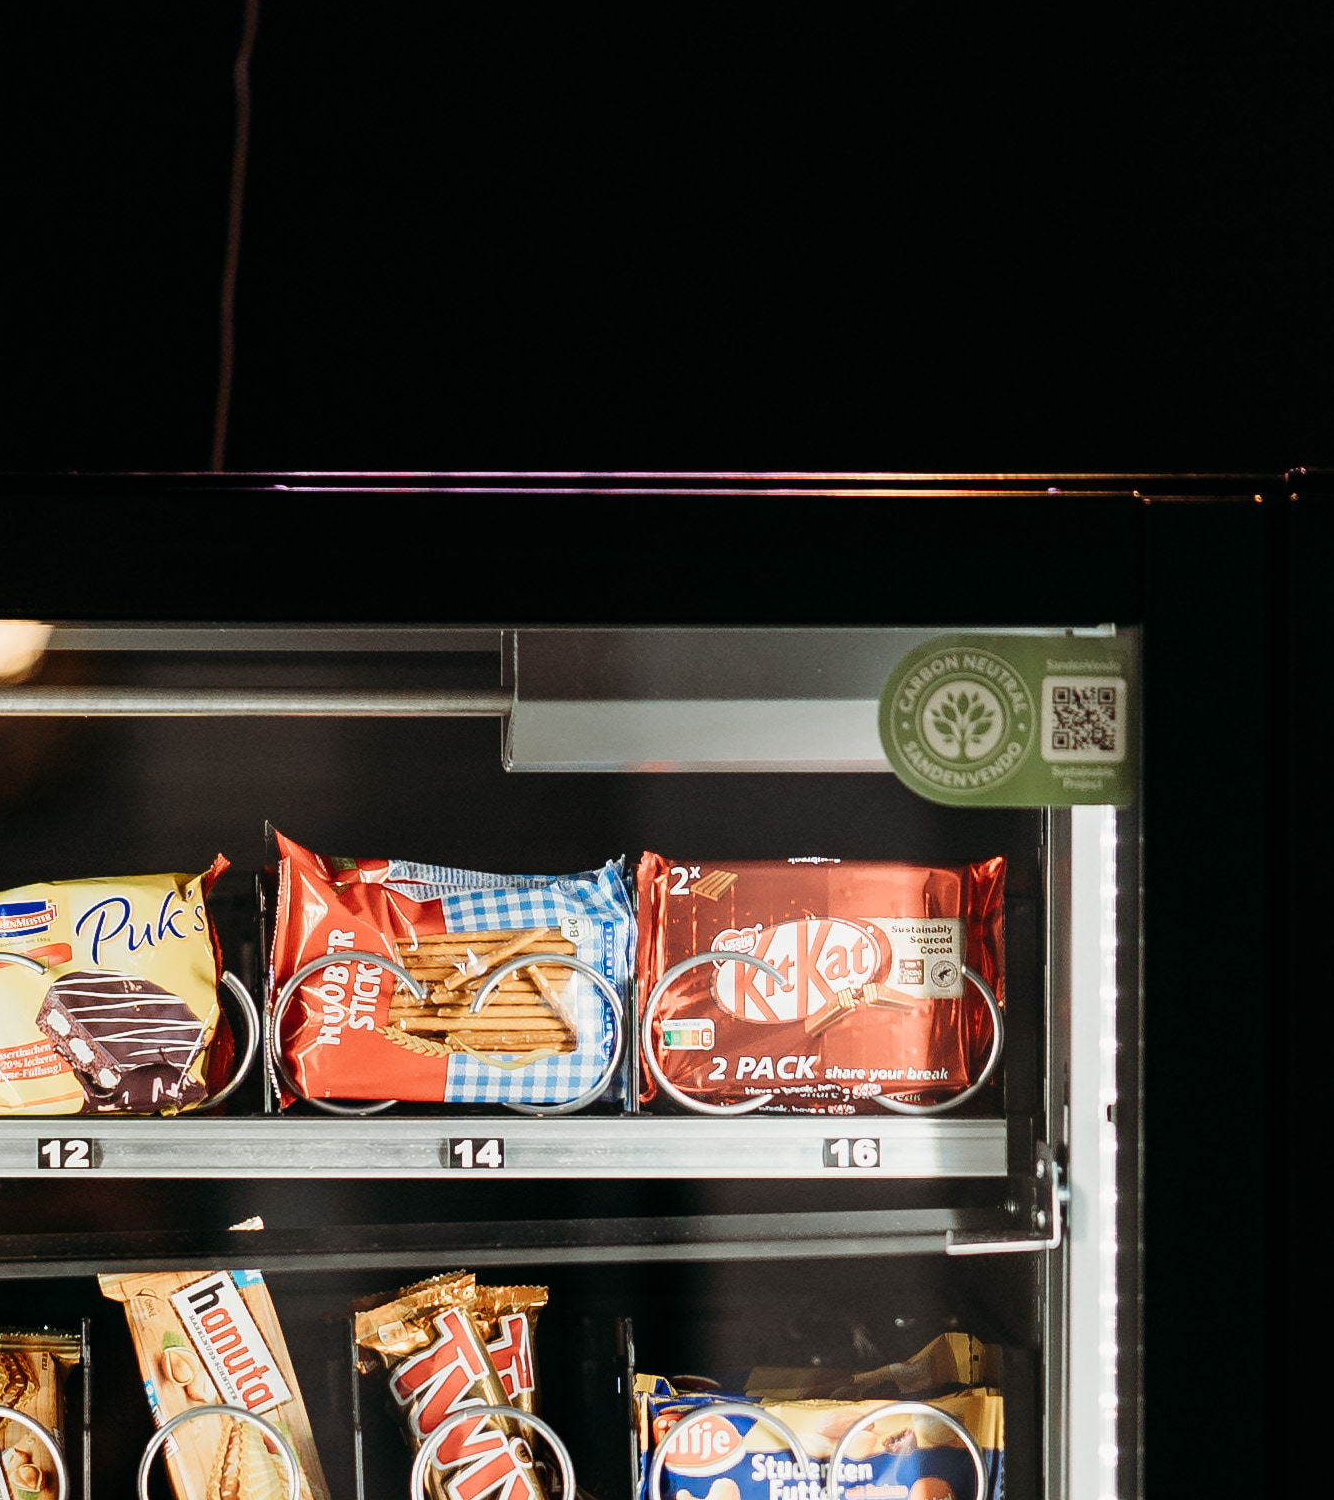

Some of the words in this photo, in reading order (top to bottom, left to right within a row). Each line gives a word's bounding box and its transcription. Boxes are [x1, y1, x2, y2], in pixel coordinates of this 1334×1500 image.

[899, 654, 958, 712] CARBON
[75, 888, 206, 966] Puk's
[891, 925, 954, 936] Sustainably
[909, 935, 954, 946] Sourced
[603, 926, 614, 977] BREZEL
[920, 946, 954, 955] Cocoa
[733, 918, 870, 1022] KitKat
[0, 1057, 24, 1072] 20%
[707, 1056, 729, 1081] 2
[736, 1055, 818, 1081] PACK
[824, 1065, 866, 1081] share
[868, 1068, 904, 1083] your
[906, 1066, 950, 1082] break
[42, 1140, 92, 1169] 12
[453, 1139, 503, 1169] 14
[829, 1139, 879, 1169] 16
[187, 1280, 275, 1412] hanuta
